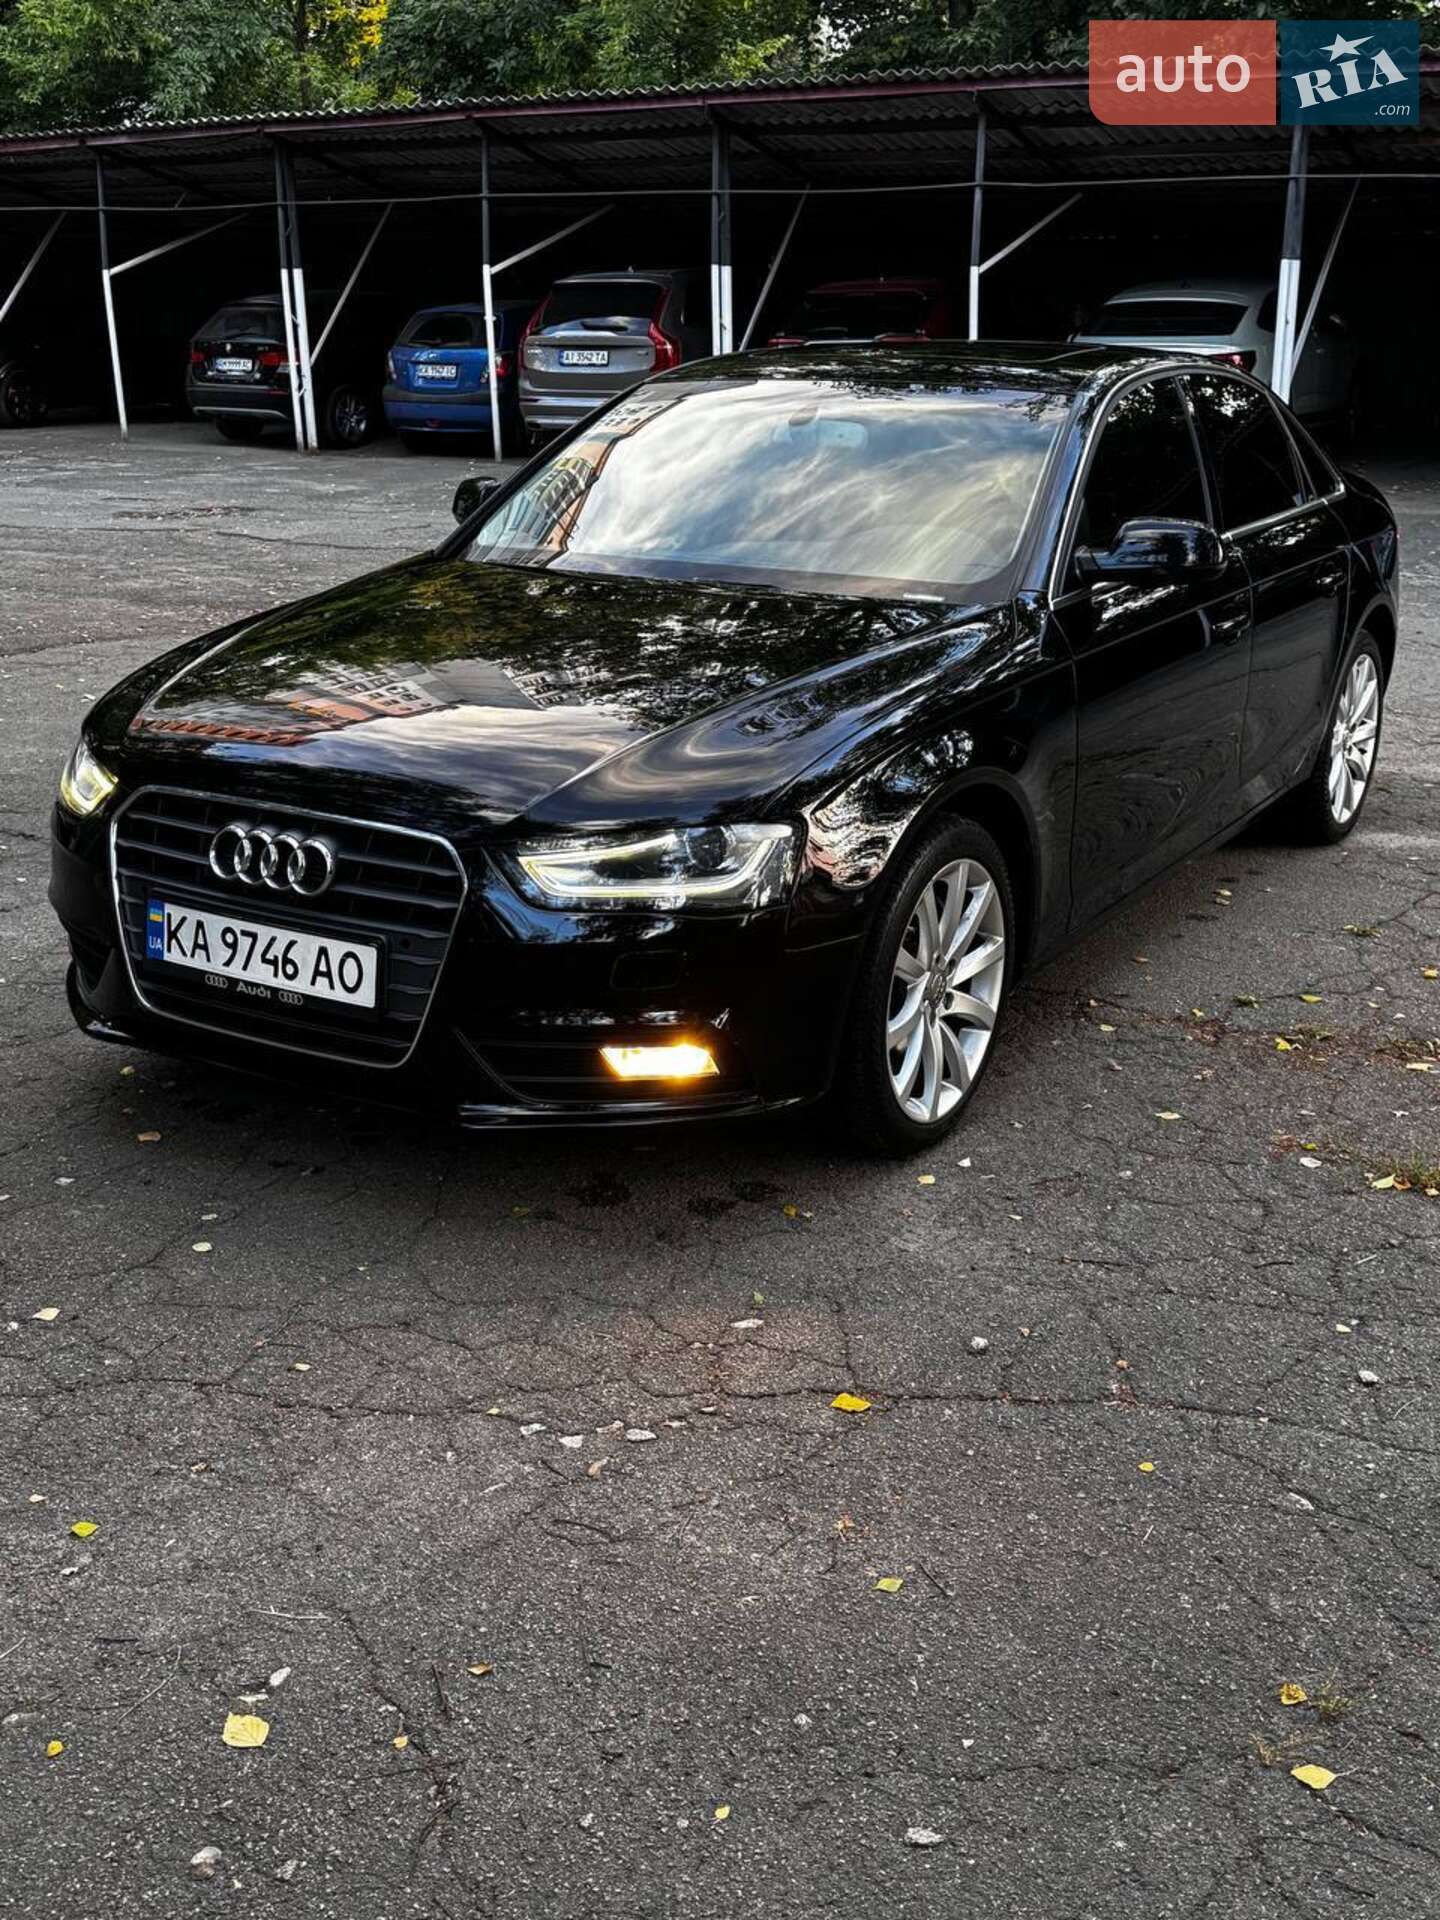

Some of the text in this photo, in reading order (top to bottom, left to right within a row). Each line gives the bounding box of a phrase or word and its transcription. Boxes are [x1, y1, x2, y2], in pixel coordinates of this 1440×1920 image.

[149, 936, 163, 951] UA
[166, 912, 363, 994] KA 9746 AO
[236, 982, 271, 999] Audi
